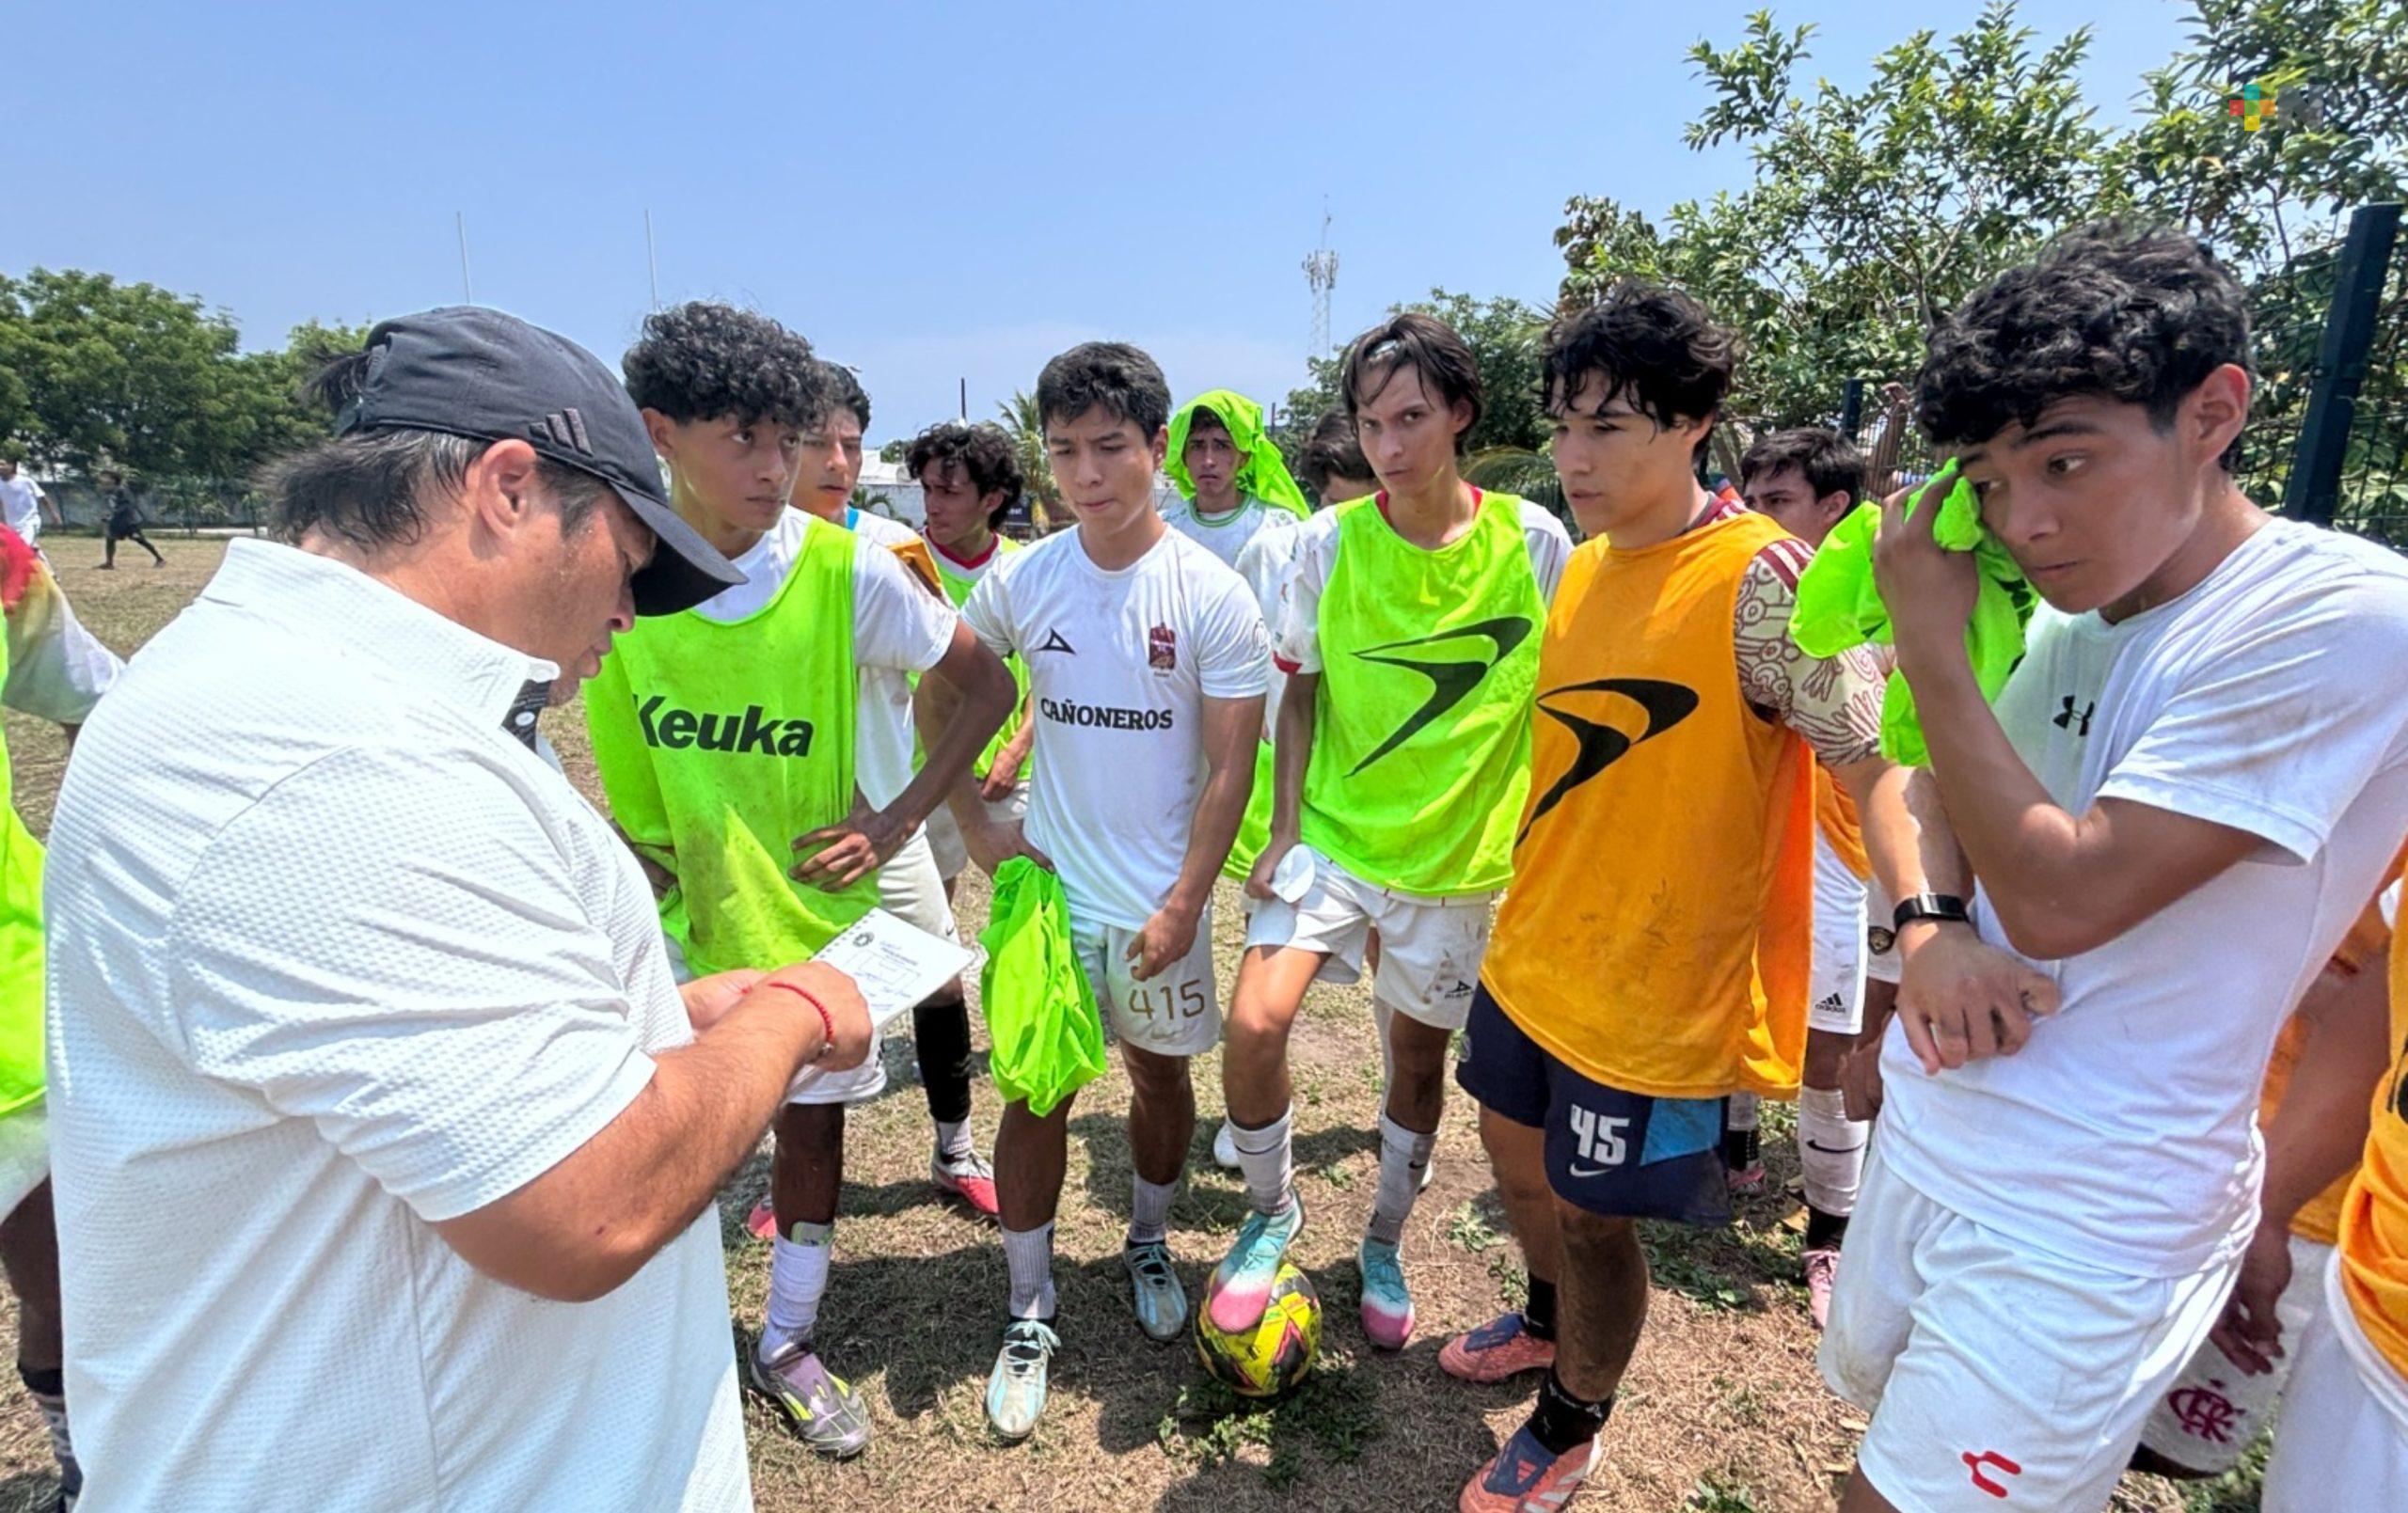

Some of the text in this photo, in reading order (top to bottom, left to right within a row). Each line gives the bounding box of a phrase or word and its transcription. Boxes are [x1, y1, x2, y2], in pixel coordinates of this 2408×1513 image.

[632, 693, 814, 757] Keuka
[1040, 698, 1173, 730] CAÑONEROS
[1130, 979, 1204, 1020] 415
[1570, 1103, 1630, 1165] 45
